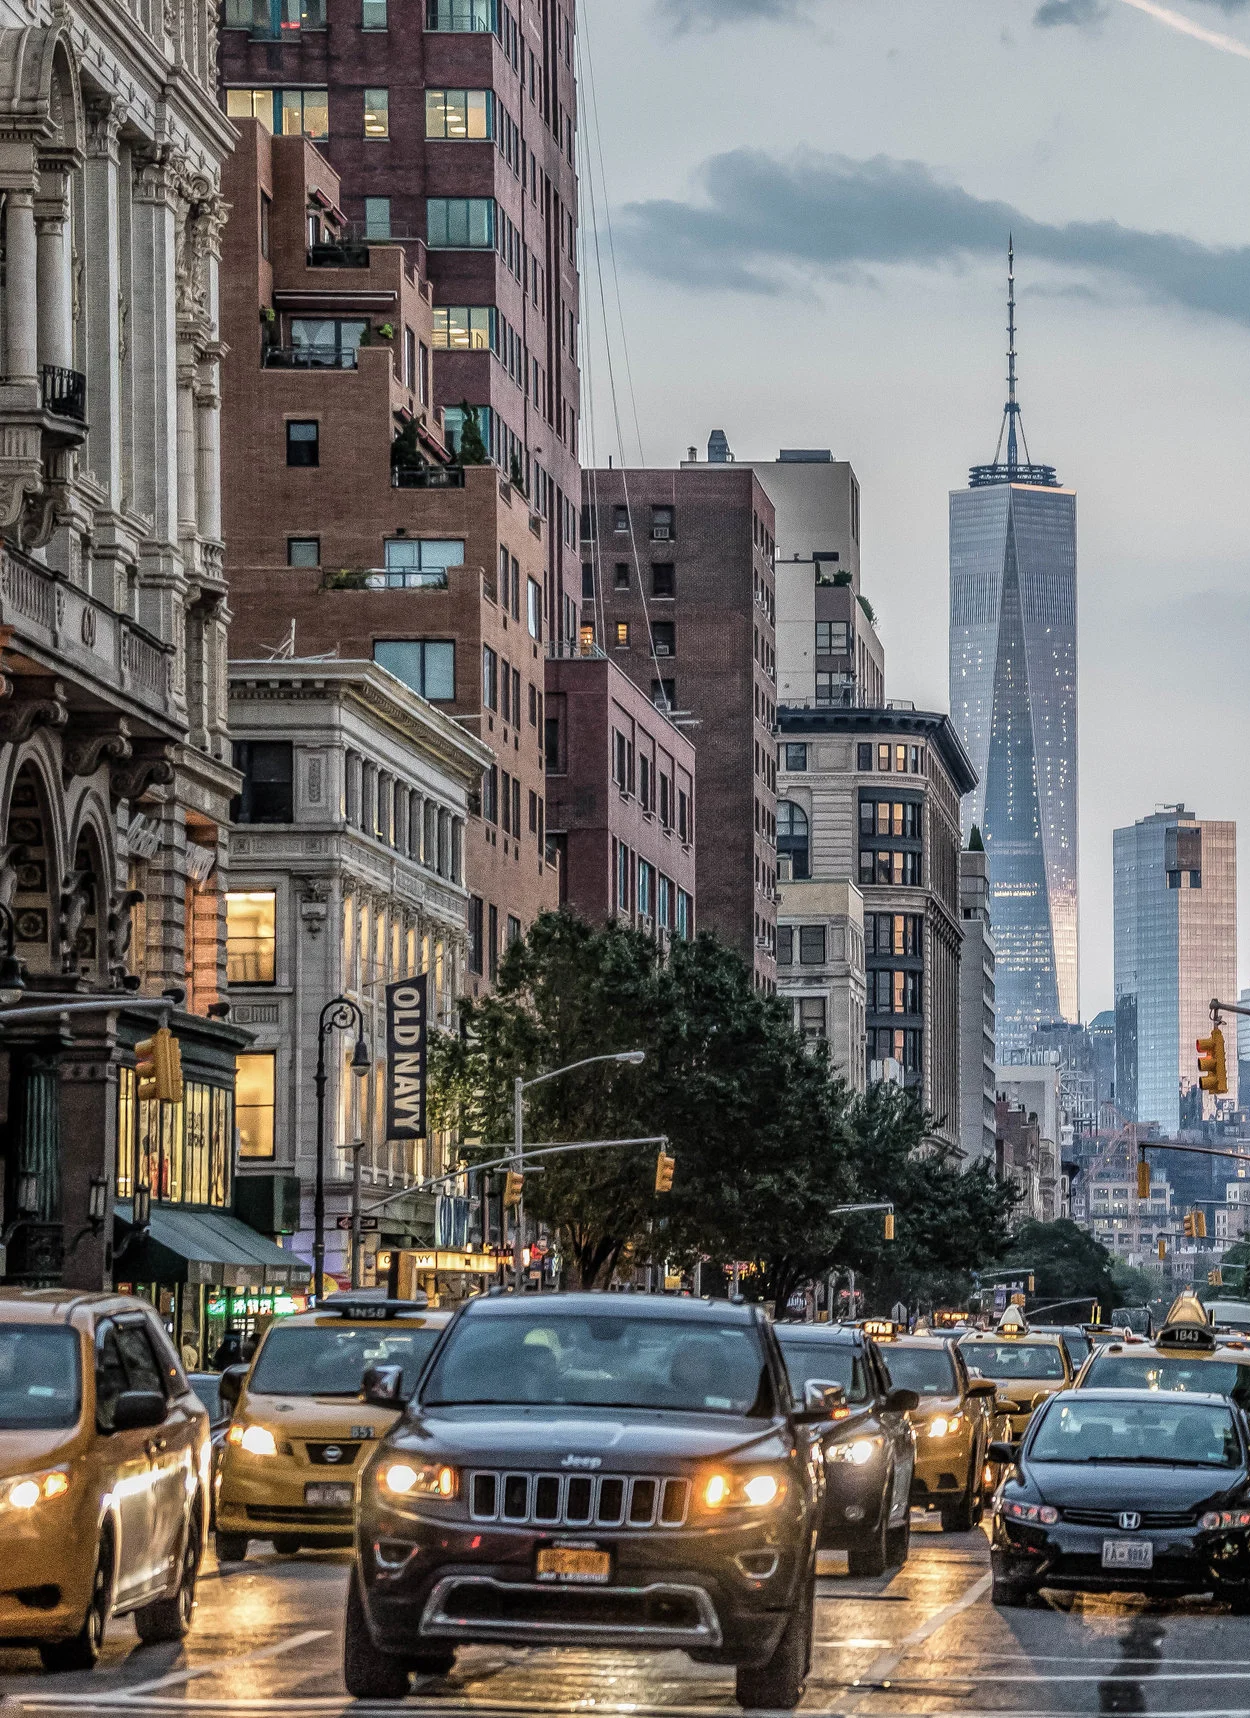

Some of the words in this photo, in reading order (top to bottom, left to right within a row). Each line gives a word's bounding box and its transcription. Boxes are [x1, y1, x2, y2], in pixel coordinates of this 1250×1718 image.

[393, 986, 421, 1046] OLD
[393, 1052, 421, 1132] NAVY
[560, 1453, 602, 1469] Jeep
